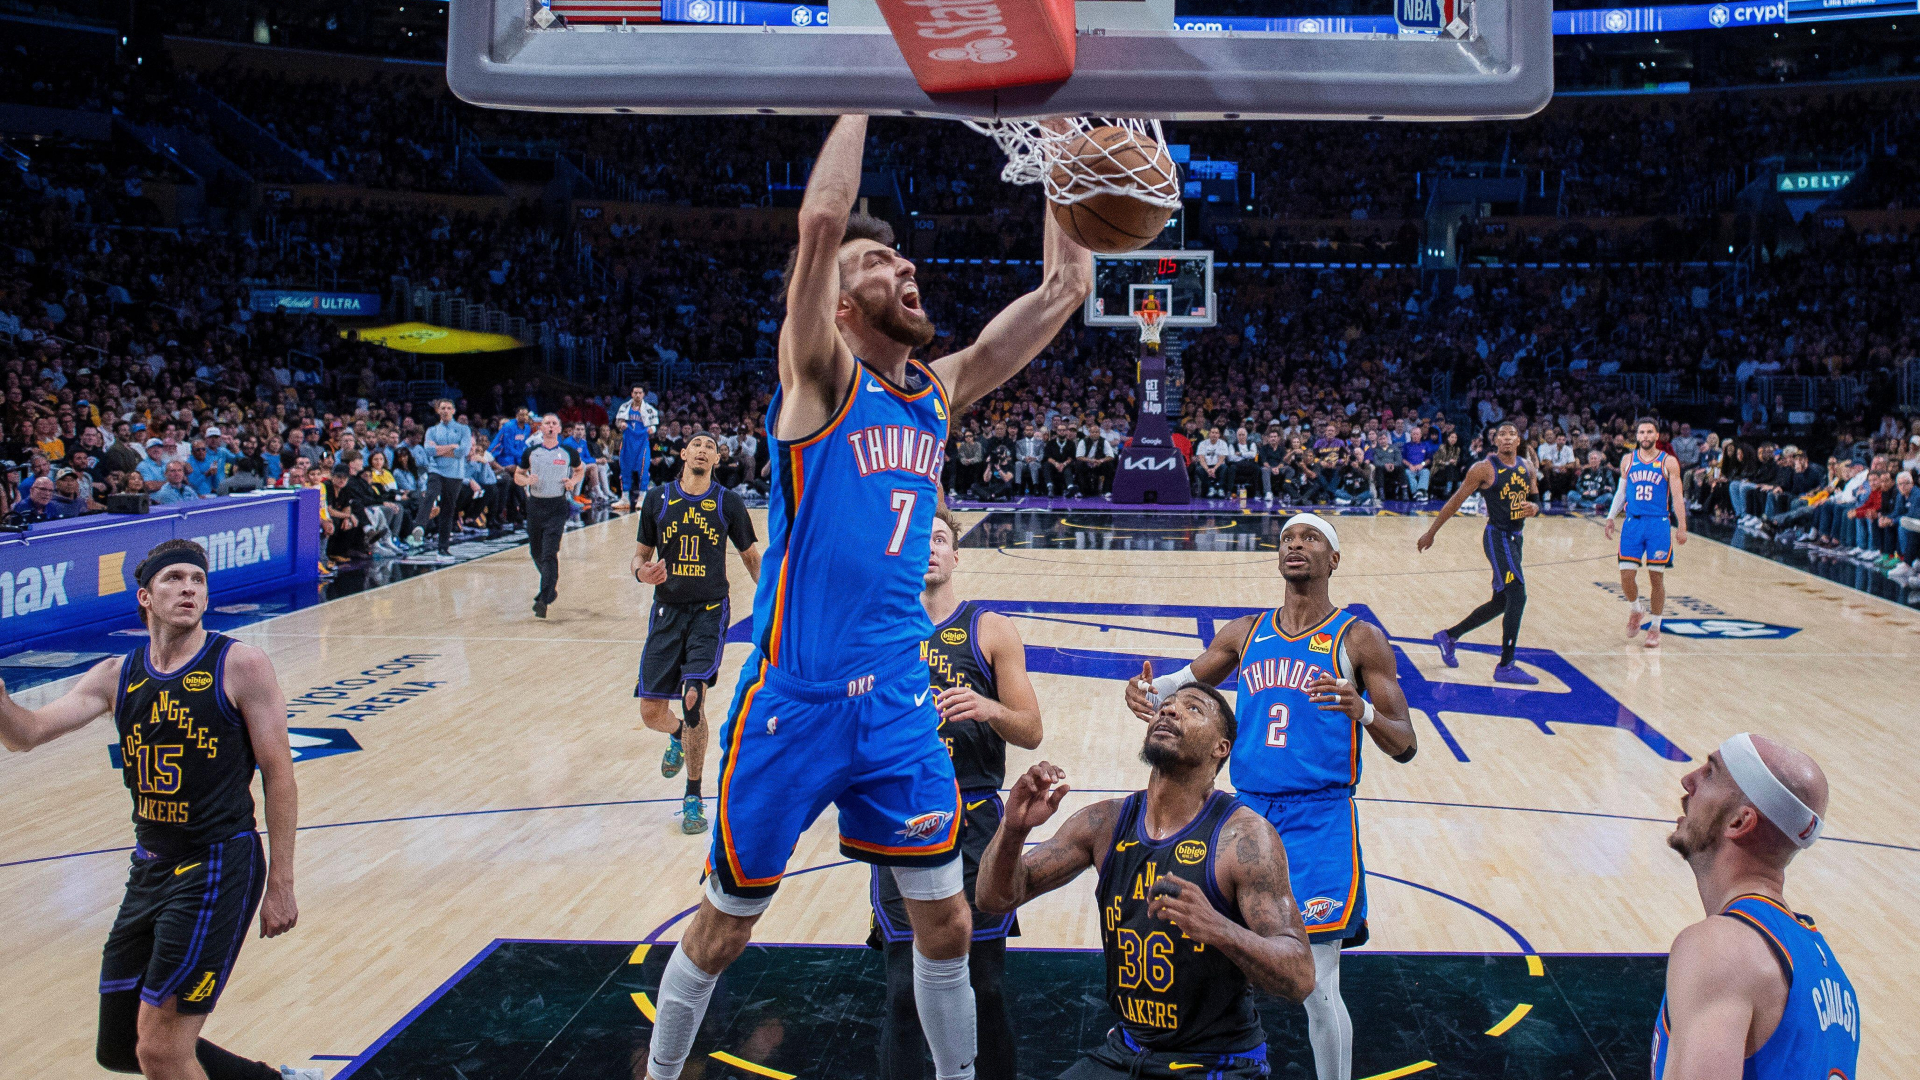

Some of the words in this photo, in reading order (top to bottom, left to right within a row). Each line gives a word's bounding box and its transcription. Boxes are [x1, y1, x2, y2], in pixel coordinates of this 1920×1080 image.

[1403, 0, 1433, 22] NBA
[321, 297, 361, 310] ULTRA
[1145, 379, 1159, 390] GET
[1145, 390, 1160, 402] THE
[1141, 437, 1162, 446] Google
[847, 425, 946, 488] THUNDE
[1629, 469, 1662, 485] THUNDER
[1635, 484, 1654, 501] 25
[662, 521, 678, 544] LOS
[682, 506, 719, 546] ANGELES
[885, 489, 918, 556] 7
[678, 534, 700, 562] 11
[672, 563, 706, 577] LAKERS
[943, 631, 966, 642] bibigo
[185, 676, 212, 686] bibigo
[848, 674, 876, 697] OKC
[1241, 656, 1333, 697] THUNDE
[326, 680, 448, 722] ARENA
[122, 723, 142, 767] LOS
[150, 690, 218, 759] ANGELES
[1264, 702, 1290, 748] 2
[136, 744, 184, 795] 15
[138, 794, 190, 824] LAKERS
[1178, 845, 1205, 858] bibigo
[1117, 927, 1174, 993] 36
[1117, 995, 1178, 1030] LAKERS
